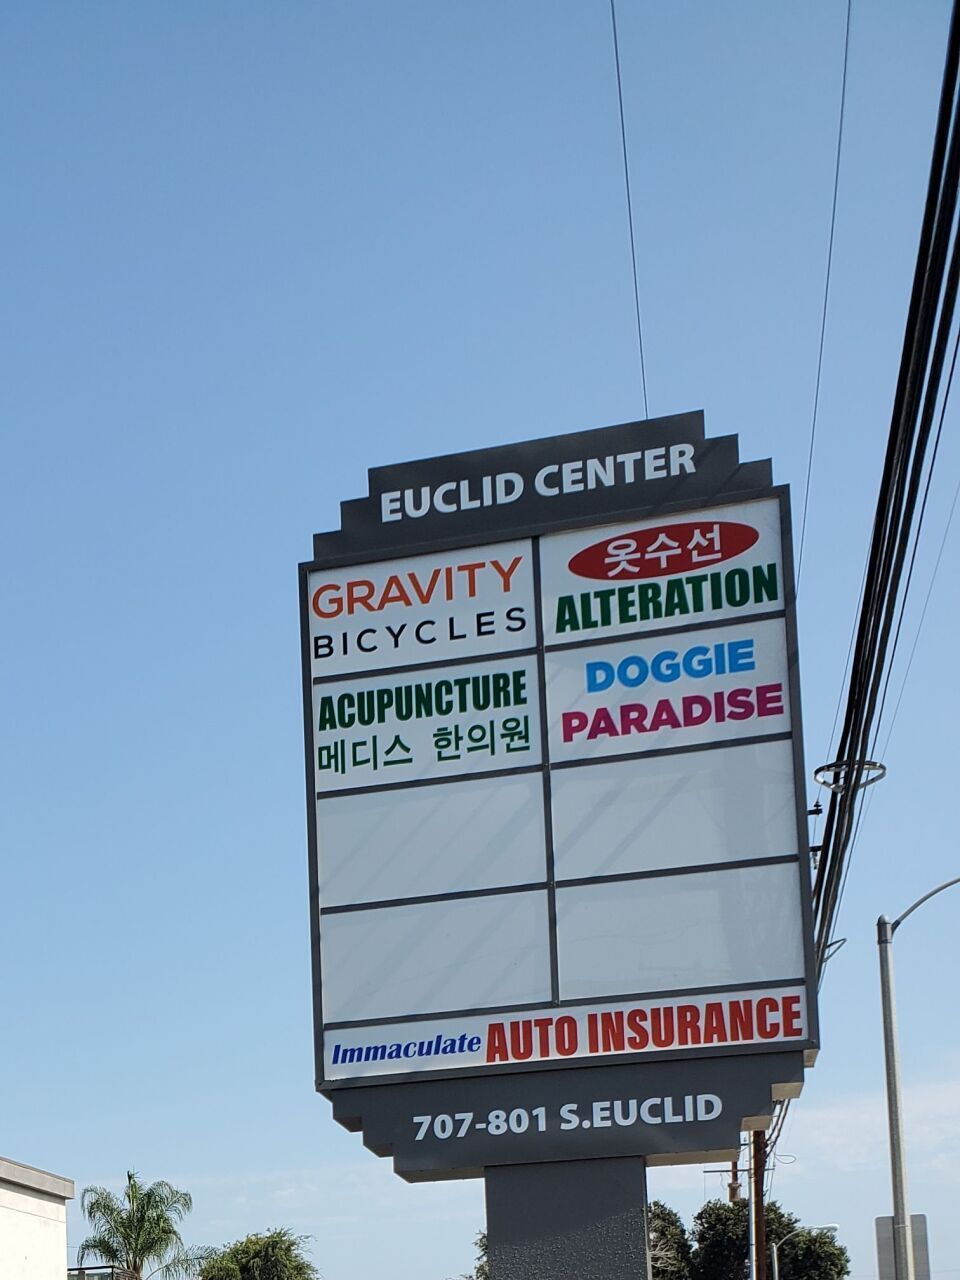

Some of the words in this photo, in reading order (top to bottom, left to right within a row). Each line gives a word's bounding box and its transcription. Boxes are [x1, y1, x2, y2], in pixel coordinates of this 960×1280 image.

[381, 472, 524, 523] EUCLID
[534, 443, 696, 496] CENTER
[604, 524, 722, 577] 옷수선
[312, 556, 523, 619] GRAVITY
[555, 563, 778, 634] ALTERATION
[313, 607, 527, 659] BICYCLES
[585, 638, 756, 693] DOGGIE
[318, 669, 528, 731] ACUPUNCTURE
[561, 683, 784, 743] PARADISE
[318, 737, 413, 775] 메디스
[433, 715, 531, 762] 한의원
[331, 1032, 481, 1065] Immaculate
[486, 1015, 578, 1064] AUTO
[588, 995, 803, 1054] INSURANCE
[412, 1106, 547, 1141] 707-801
[559, 1094, 723, 1131] S.EUCLID
